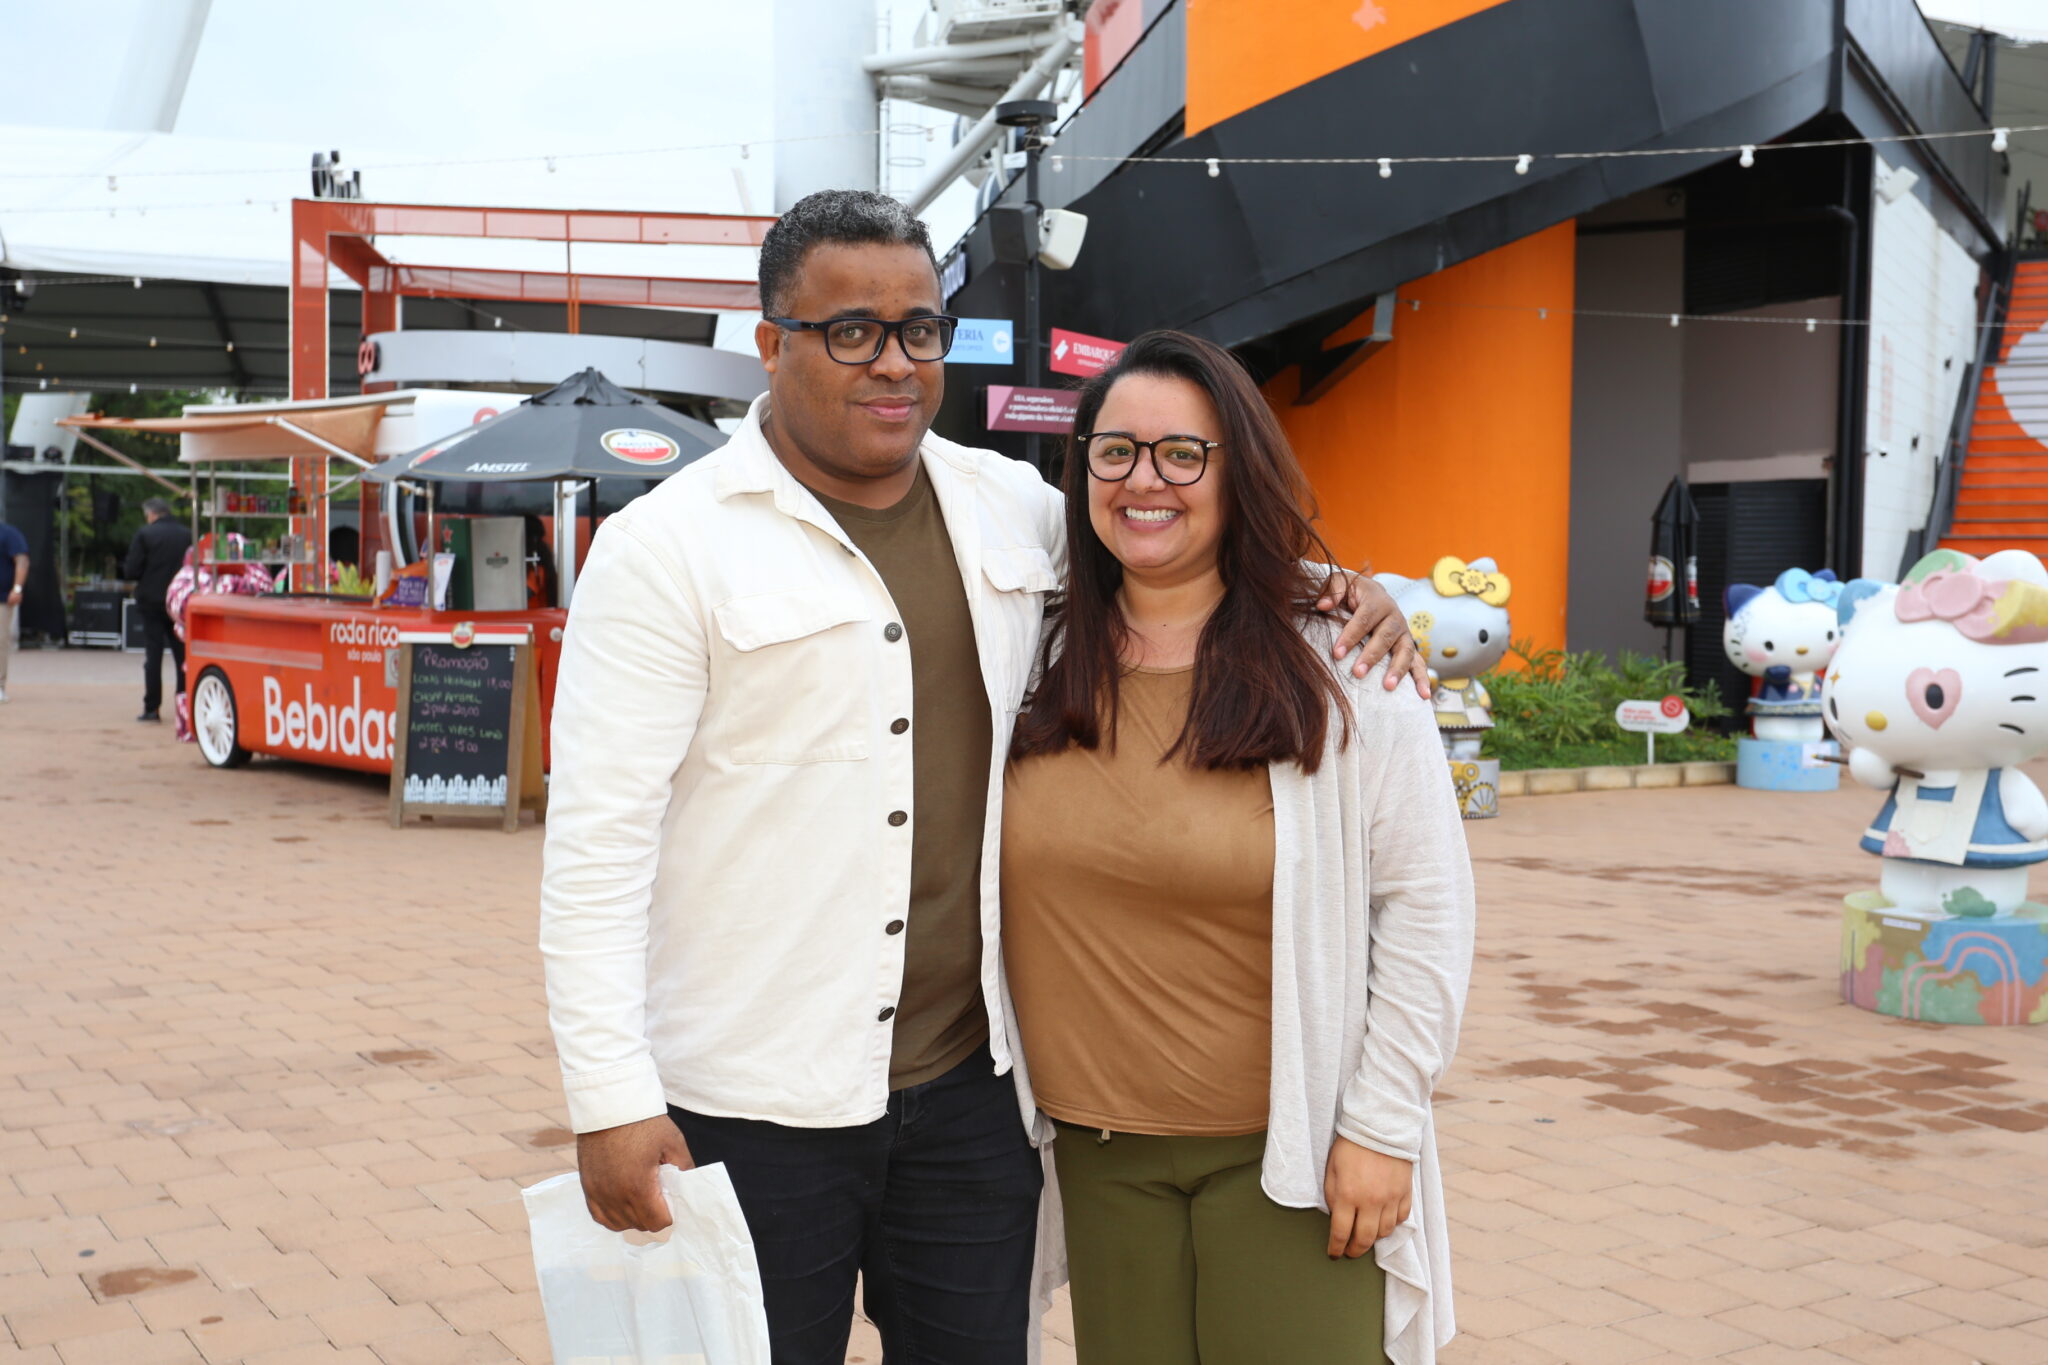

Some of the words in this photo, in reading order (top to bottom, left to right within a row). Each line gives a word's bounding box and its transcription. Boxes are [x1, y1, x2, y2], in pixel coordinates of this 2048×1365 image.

[465, 462, 532, 473] AMSTEL
[330, 616, 366, 644] roda
[368, 618, 399, 647] rico
